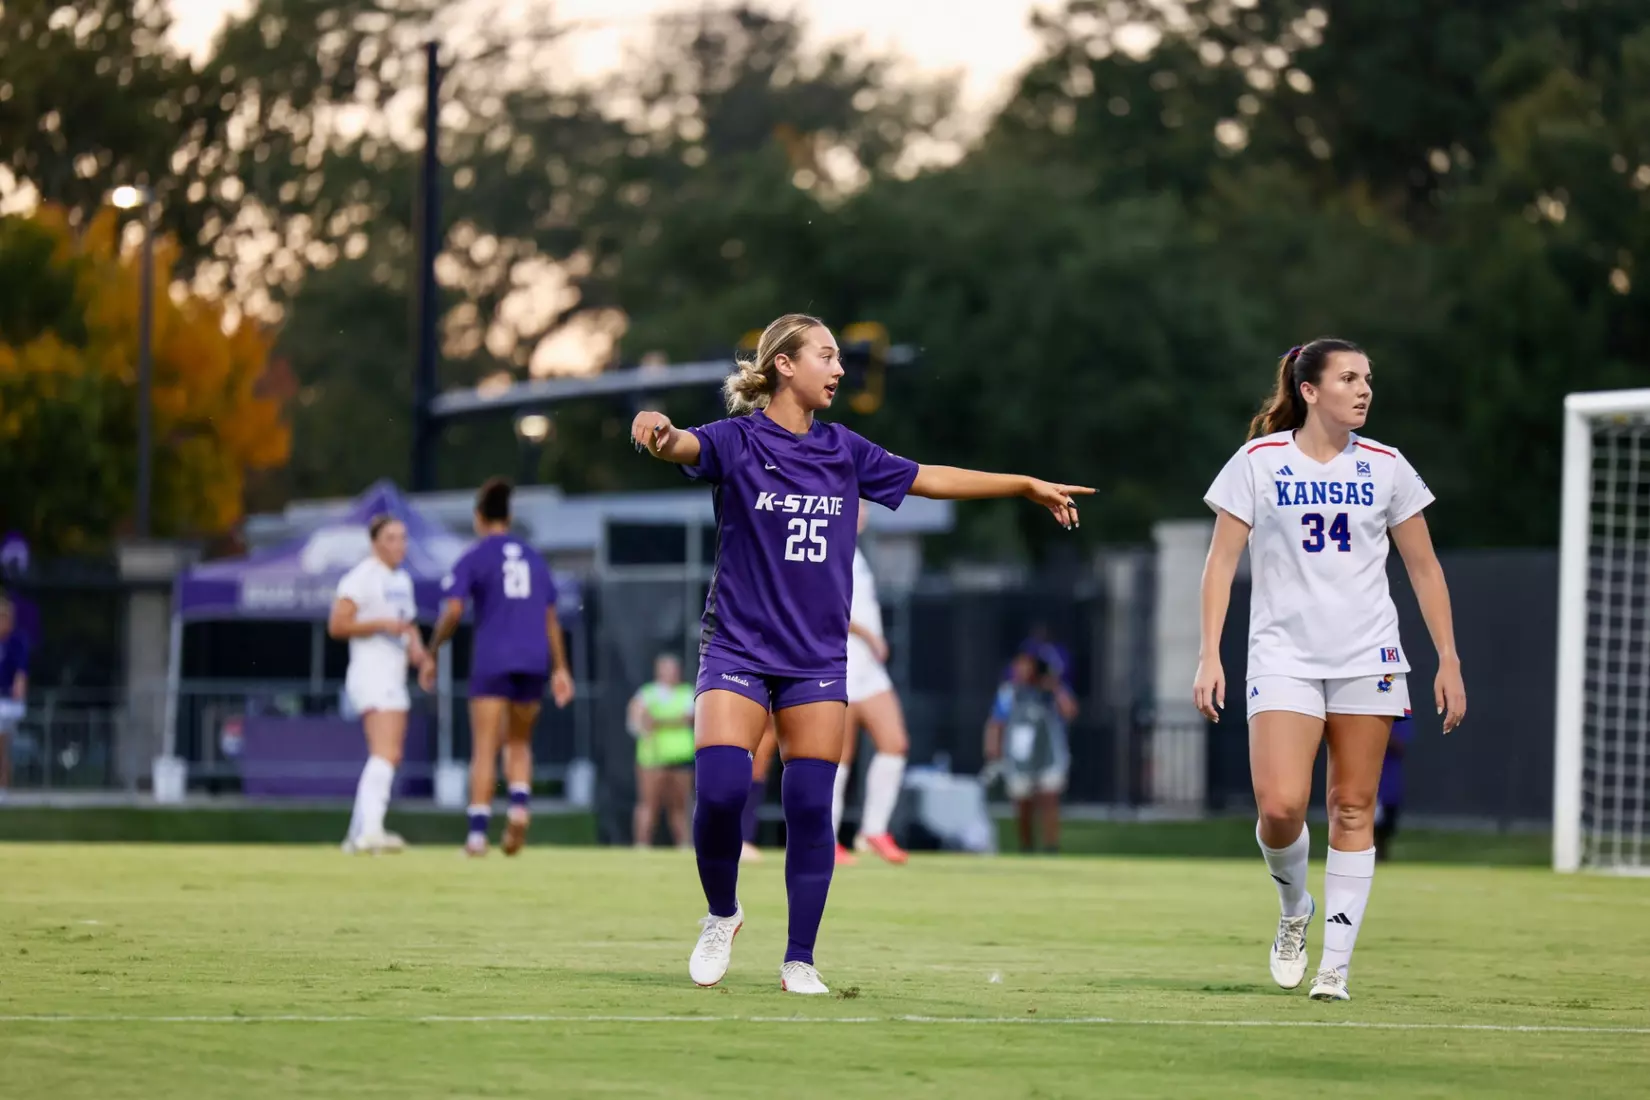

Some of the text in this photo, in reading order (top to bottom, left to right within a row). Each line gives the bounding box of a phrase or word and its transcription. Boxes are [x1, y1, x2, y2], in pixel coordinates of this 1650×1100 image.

[755, 492, 843, 515] K-STATE
[1275, 481, 1374, 506] KANSAS
[785, 518, 828, 562] 25
[1301, 512, 1351, 553] 34
